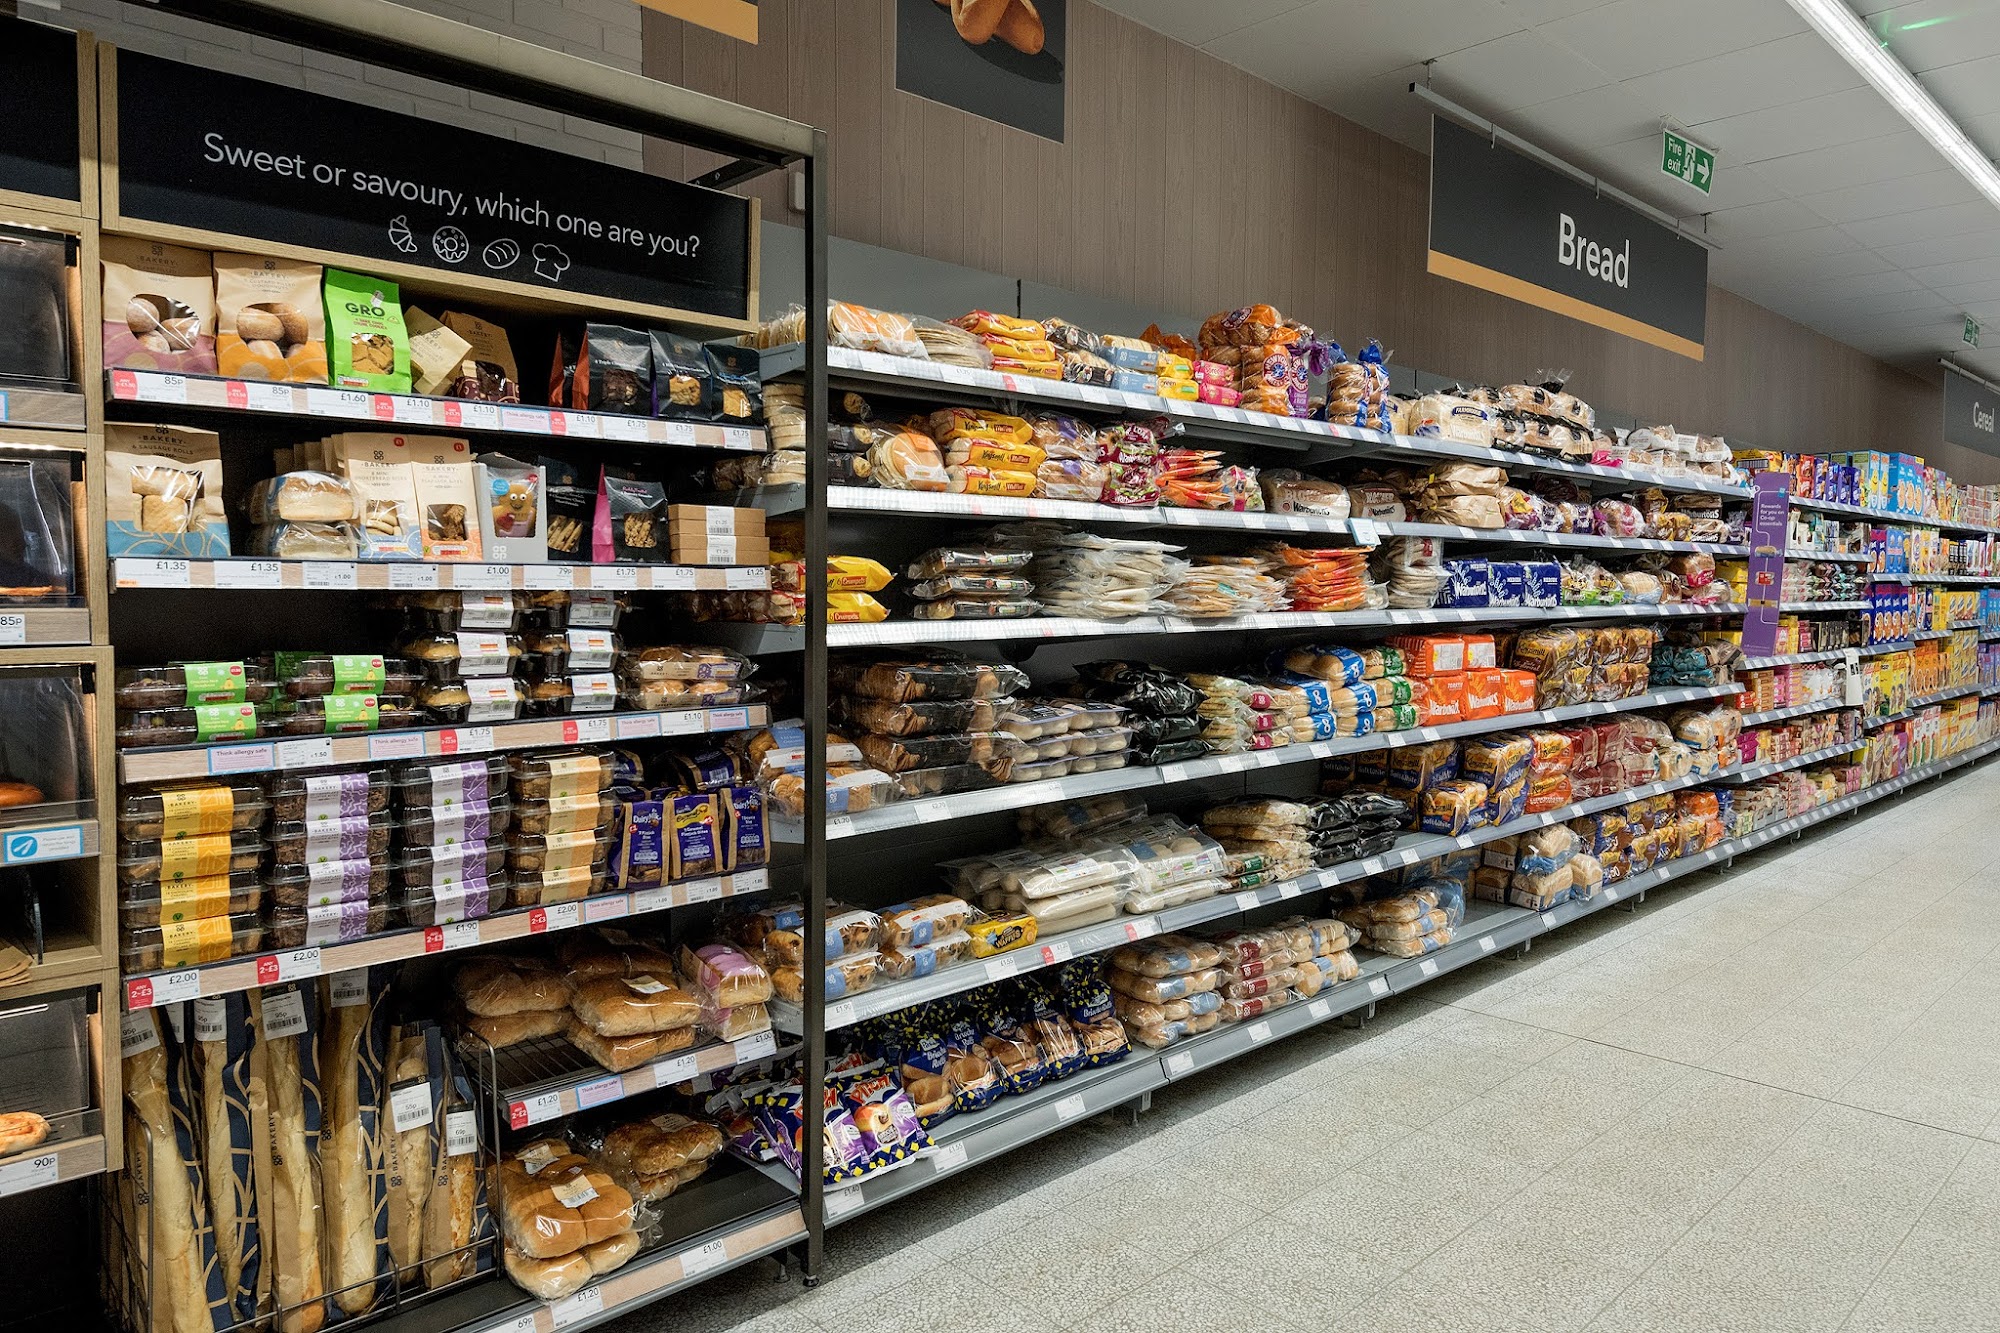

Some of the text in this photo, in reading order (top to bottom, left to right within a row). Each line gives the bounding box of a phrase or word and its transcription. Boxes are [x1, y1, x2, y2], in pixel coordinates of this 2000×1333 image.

[1668, 137, 1683, 156] Fire
[1667, 158, 1681, 174] exit
[204, 133, 701, 257] Sweet or savoury, which one are you?
[1557, 212, 1631, 289] Bread
[345, 302, 386, 317] GRO
[164, 376, 184, 386] 85p
[272, 387, 290, 396] 85p
[341, 393, 366, 402] £1.60
[407, 399, 430, 407] £1.10
[473, 405, 495, 413] £1.10
[1973, 401, 1995, 433] Cereal
[627, 420, 647, 428] £1.75
[142, 435, 184, 444] BAKERY
[157, 561, 187, 570] £1.35
[251, 563, 279, 572] £1.35
[487, 567, 509, 575] £1.00
[616, 568, 636, 576] £1.75
[0, 616, 22, 626] 85p
[1312, 690, 1321, 706] 8
[1364, 692, 1372, 707] 8
[1323, 717, 1331, 733] 8
[1363, 718, 1371, 732] 8
[470, 728, 490, 736] £1.75
[633, 814, 648, 824] Dairy
[558, 905, 577, 914] £2.00
[455, 922, 478, 933] £1.90
[293, 951, 319, 962] £2.00
[169, 973, 198, 985] £2.00
[122, 1028, 137, 1036] 95p
[755, 1033, 773, 1042] £1.00
[677, 1056, 696, 1066] £1.20
[538, 1095, 558, 1106] £1.20
[391, 1141, 399, 1171] BAKERY
[34, 1157, 56, 1168] 90p
[703, 1241, 722, 1254] £1.00
[577, 1288, 599, 1302] £1.20
[518, 1317, 534, 1329] 69p
